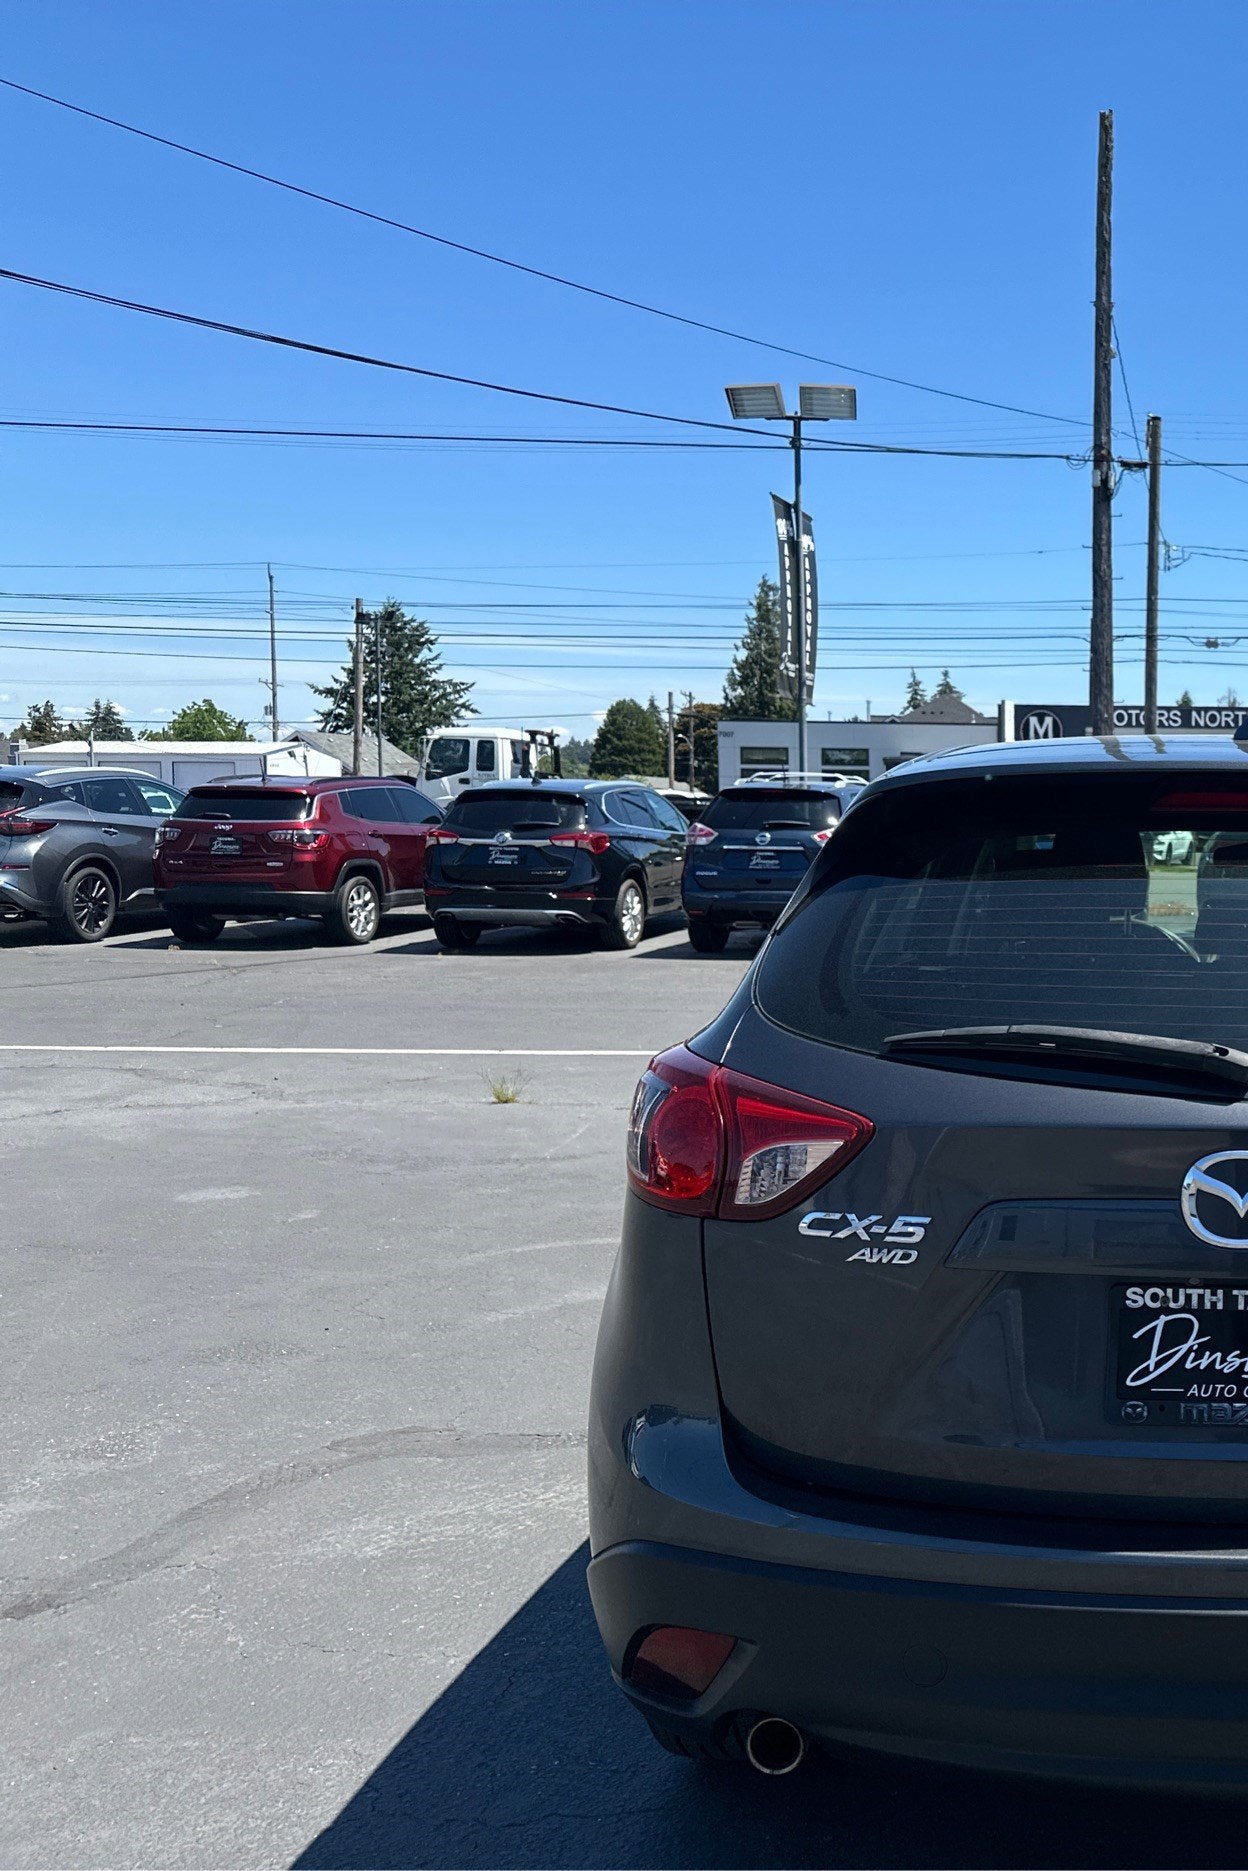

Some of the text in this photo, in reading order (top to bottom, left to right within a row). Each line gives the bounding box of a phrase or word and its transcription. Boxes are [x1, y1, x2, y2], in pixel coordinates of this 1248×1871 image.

[783, 543, 792, 656] APPROVAL
[804, 557, 813, 666] APPROVAL
[1029, 716, 1053, 740] M
[798, 1211, 932, 1244] CX-5
[845, 1247, 919, 1265] AWD
[1125, 1287, 1224, 1310] SOUTH
[1187, 1384, 1237, 1398] AUTO
